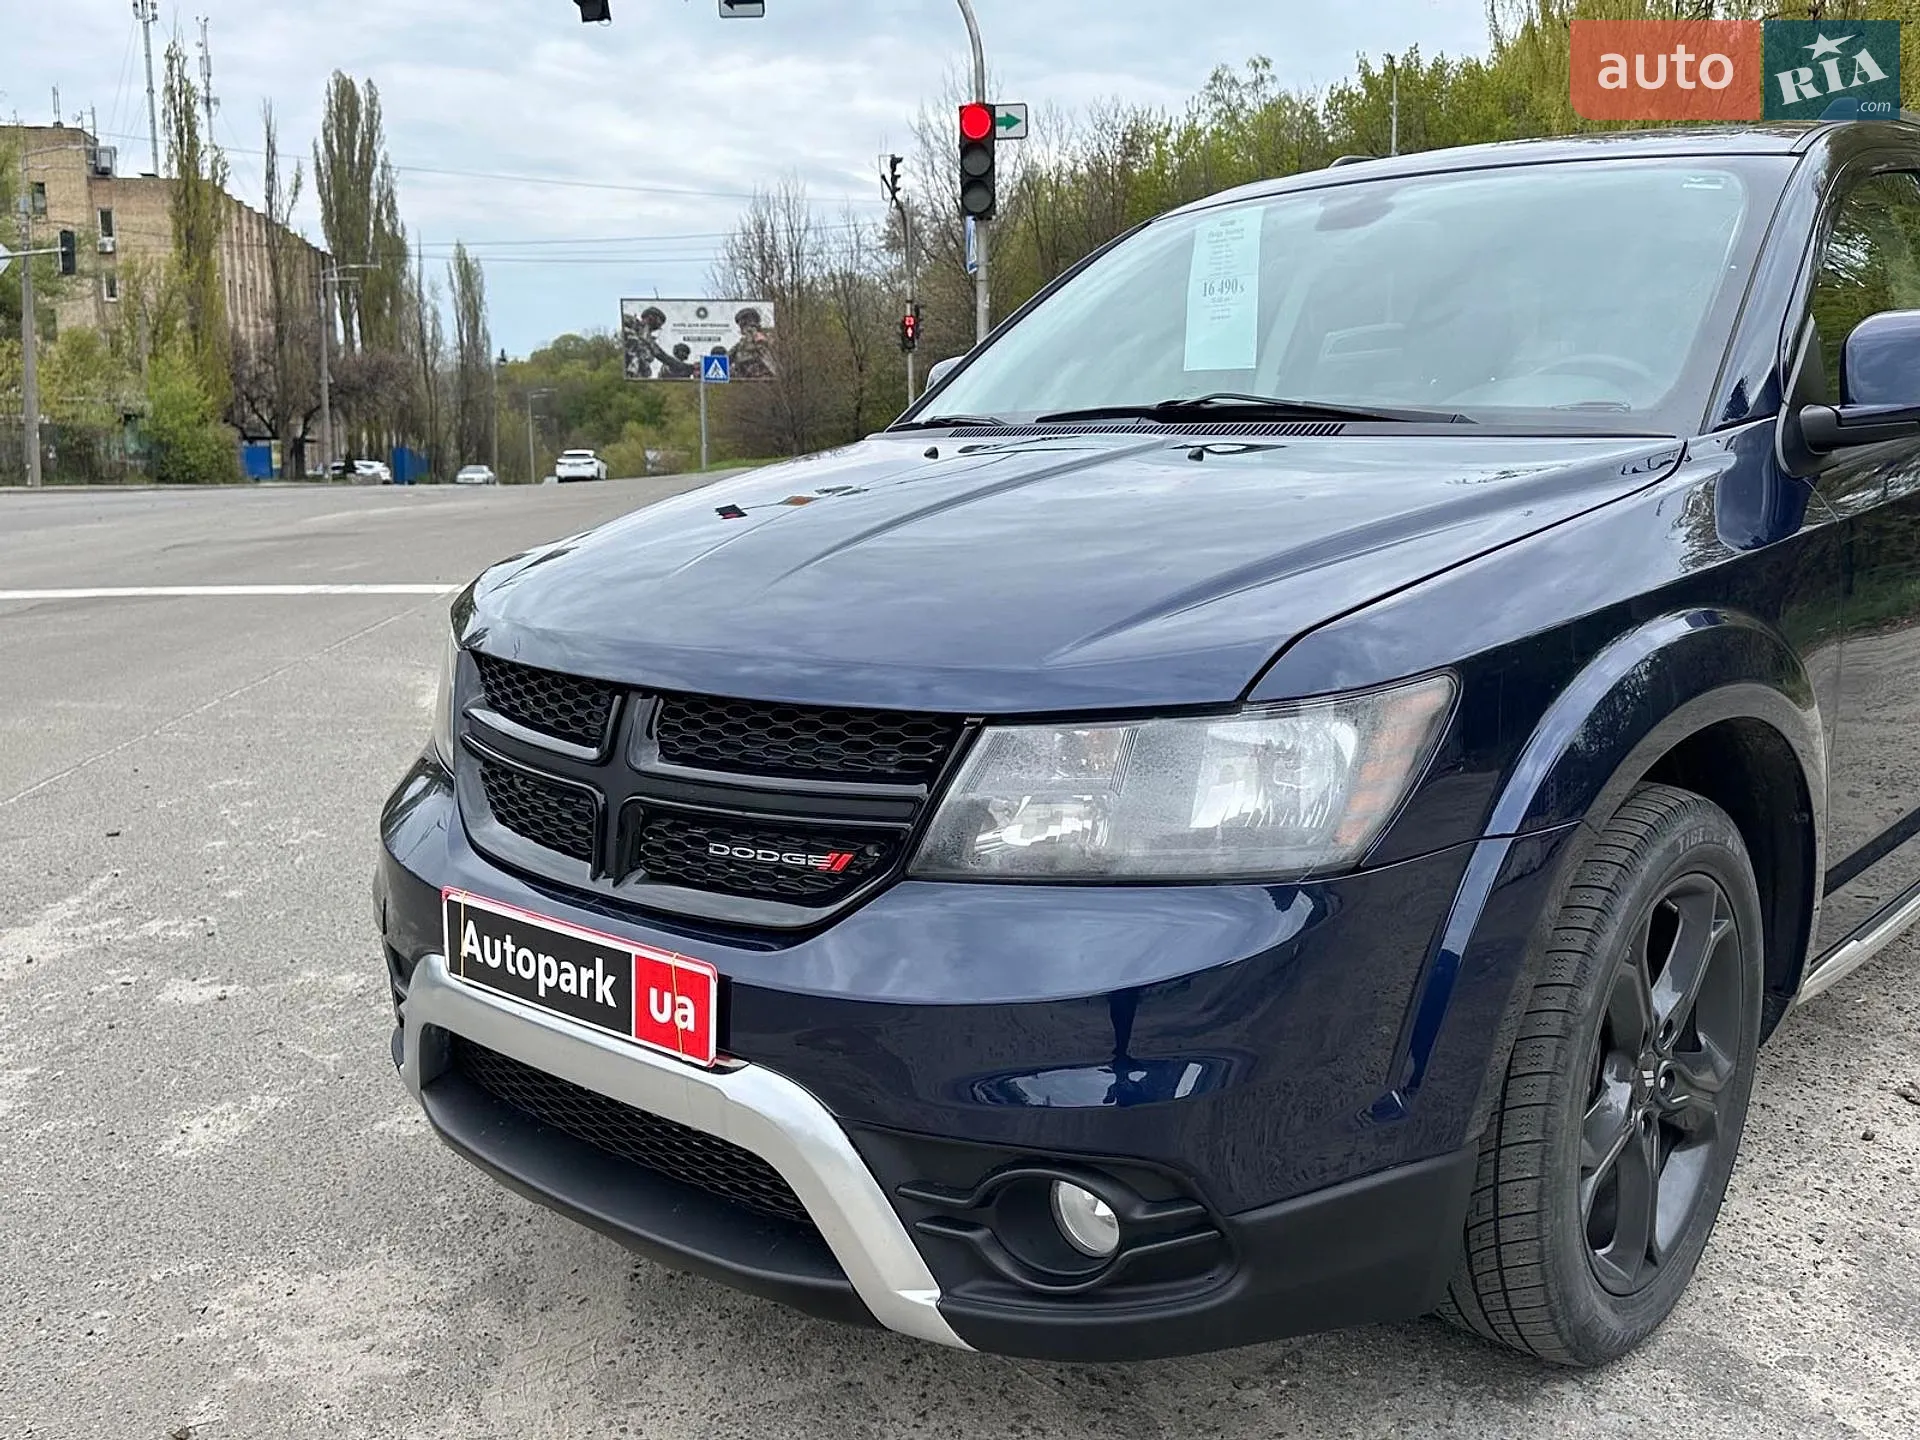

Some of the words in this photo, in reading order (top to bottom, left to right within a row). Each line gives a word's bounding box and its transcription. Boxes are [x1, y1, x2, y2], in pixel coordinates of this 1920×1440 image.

[1203, 280, 1215, 297] 16
[1218, 279, 1239, 295] 490
[708, 842, 832, 867] DODGE
[463, 920, 618, 1008] Autopark
[649, 987, 695, 1032] ua
